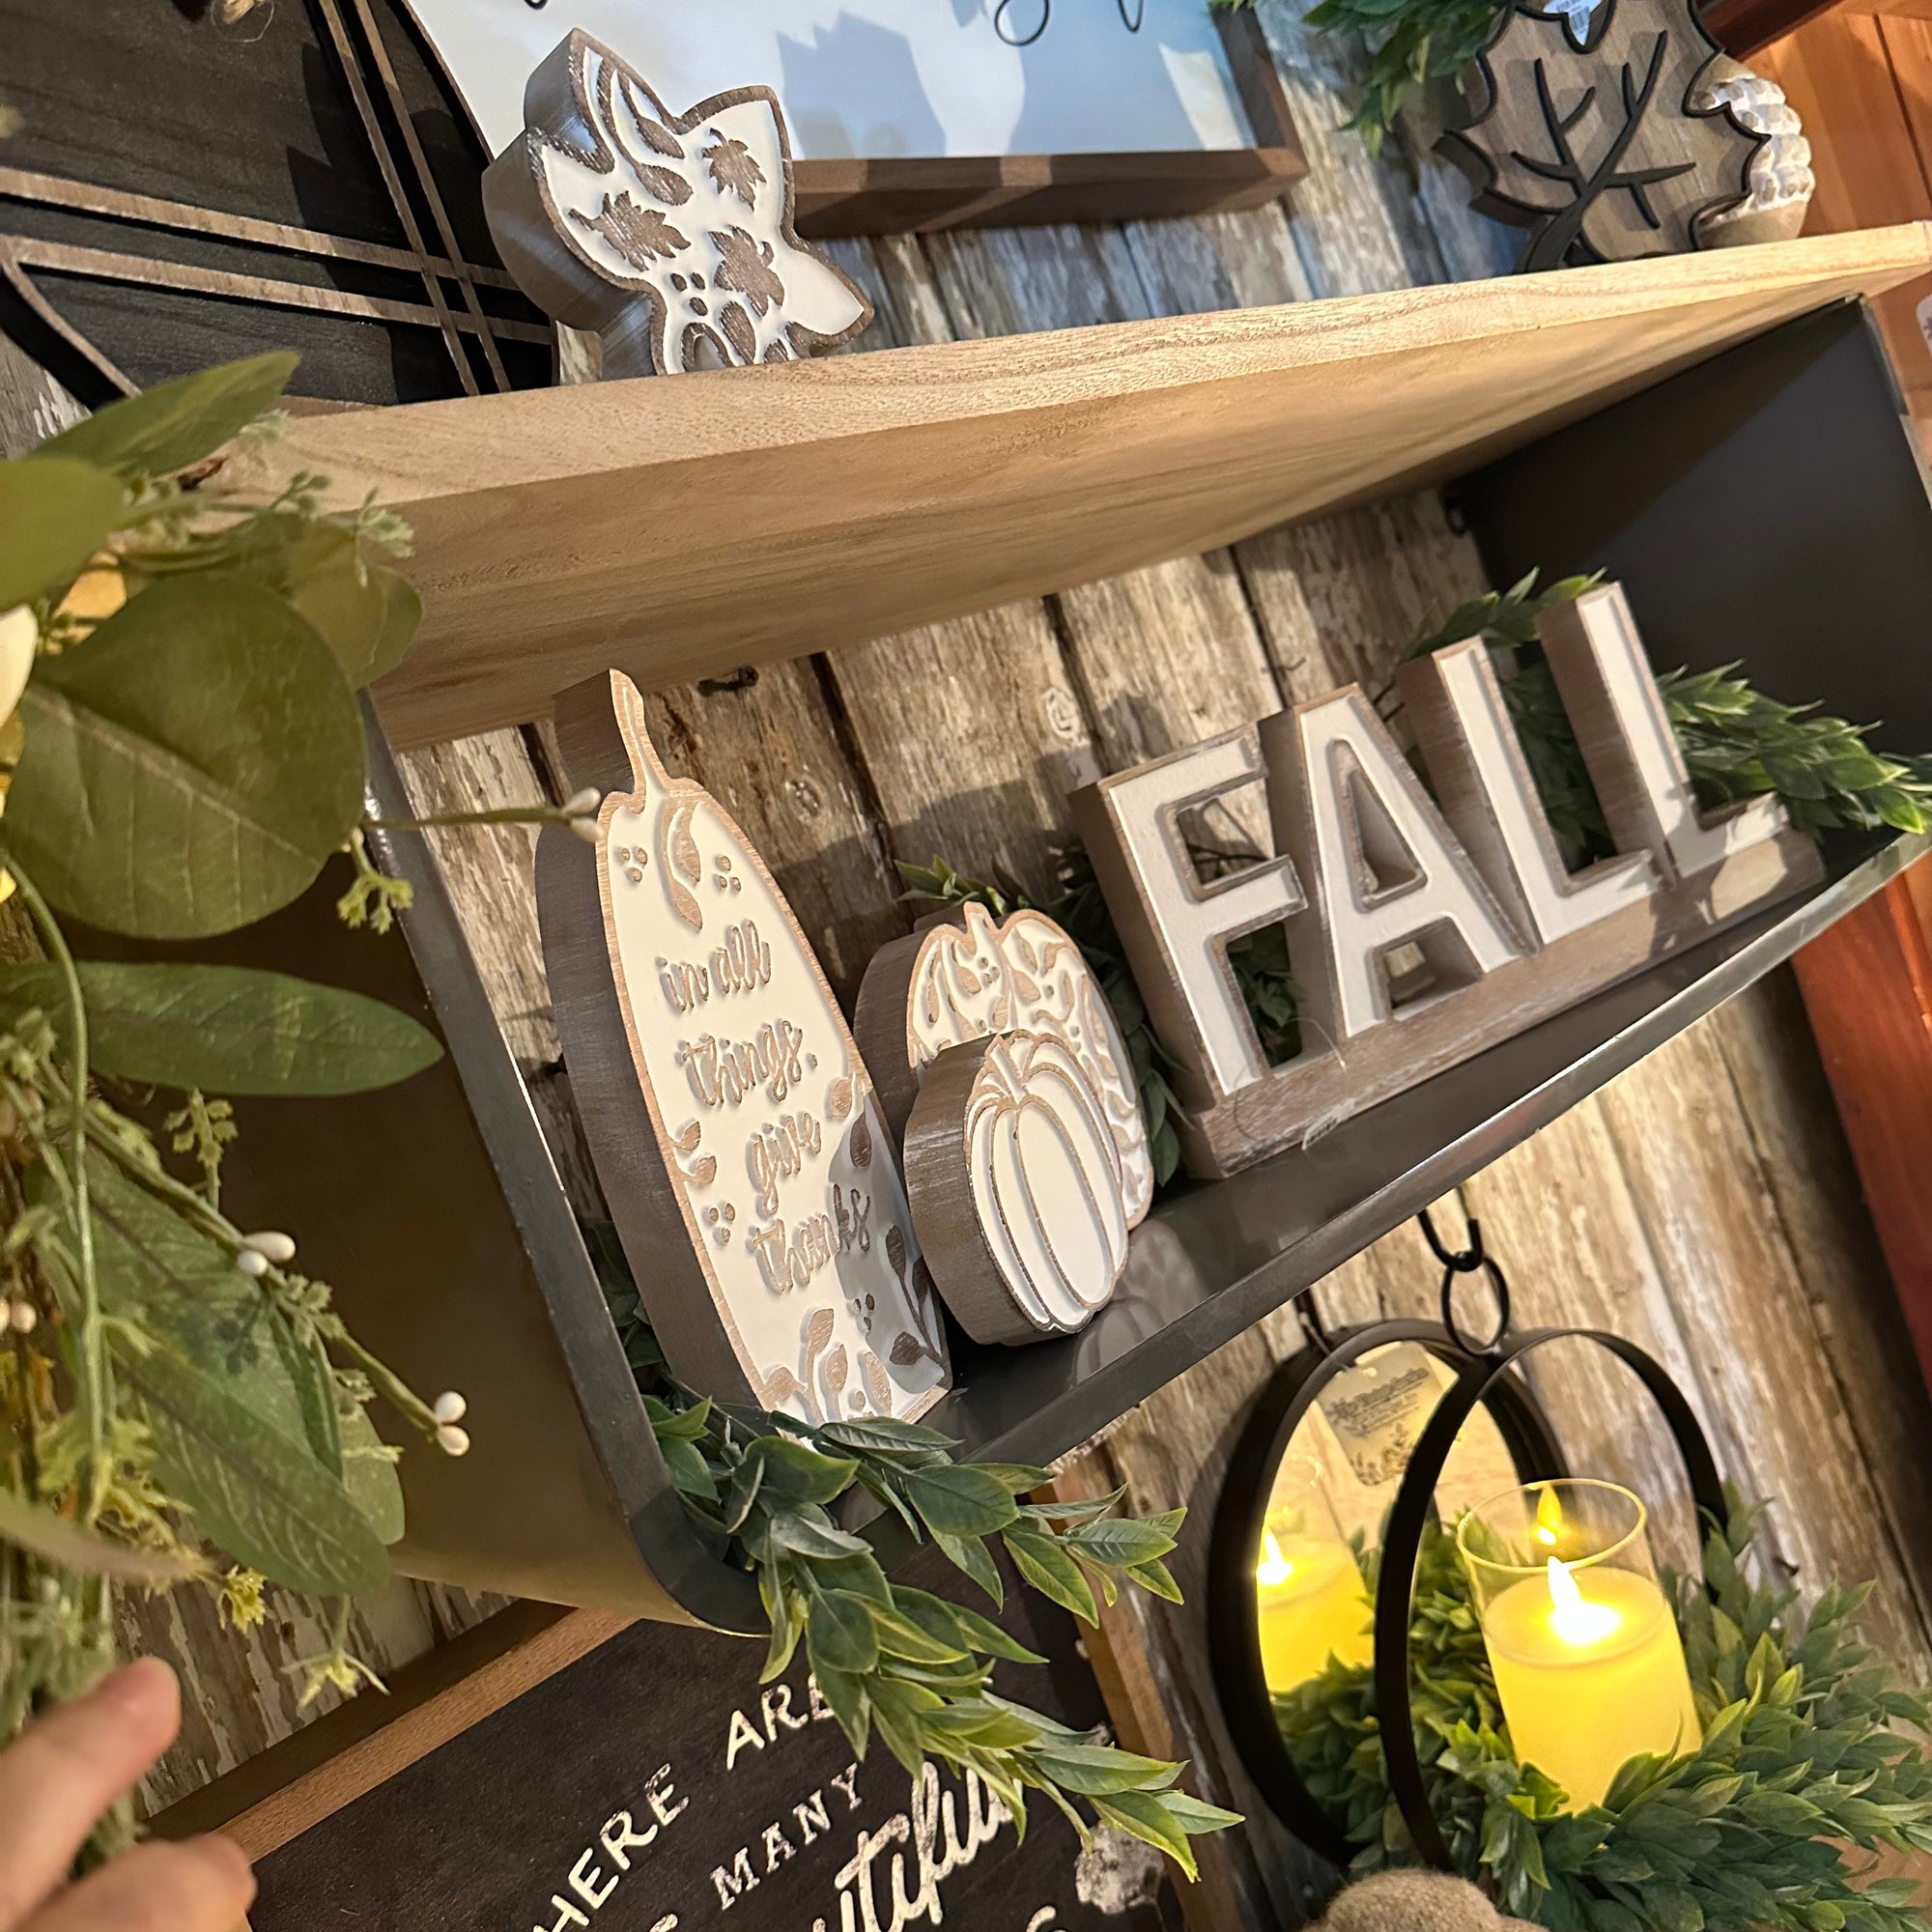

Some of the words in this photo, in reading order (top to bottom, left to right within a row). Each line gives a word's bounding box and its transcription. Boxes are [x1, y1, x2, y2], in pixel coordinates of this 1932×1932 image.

[1098, 582, 1789, 1096] FALL
[657, 955, 709, 1012] in
[711, 919, 772, 994] all
[751, 1111, 821, 1215] give
[752, 1183, 871, 1294] thanks
[710, 1762, 863, 1910] MANY
